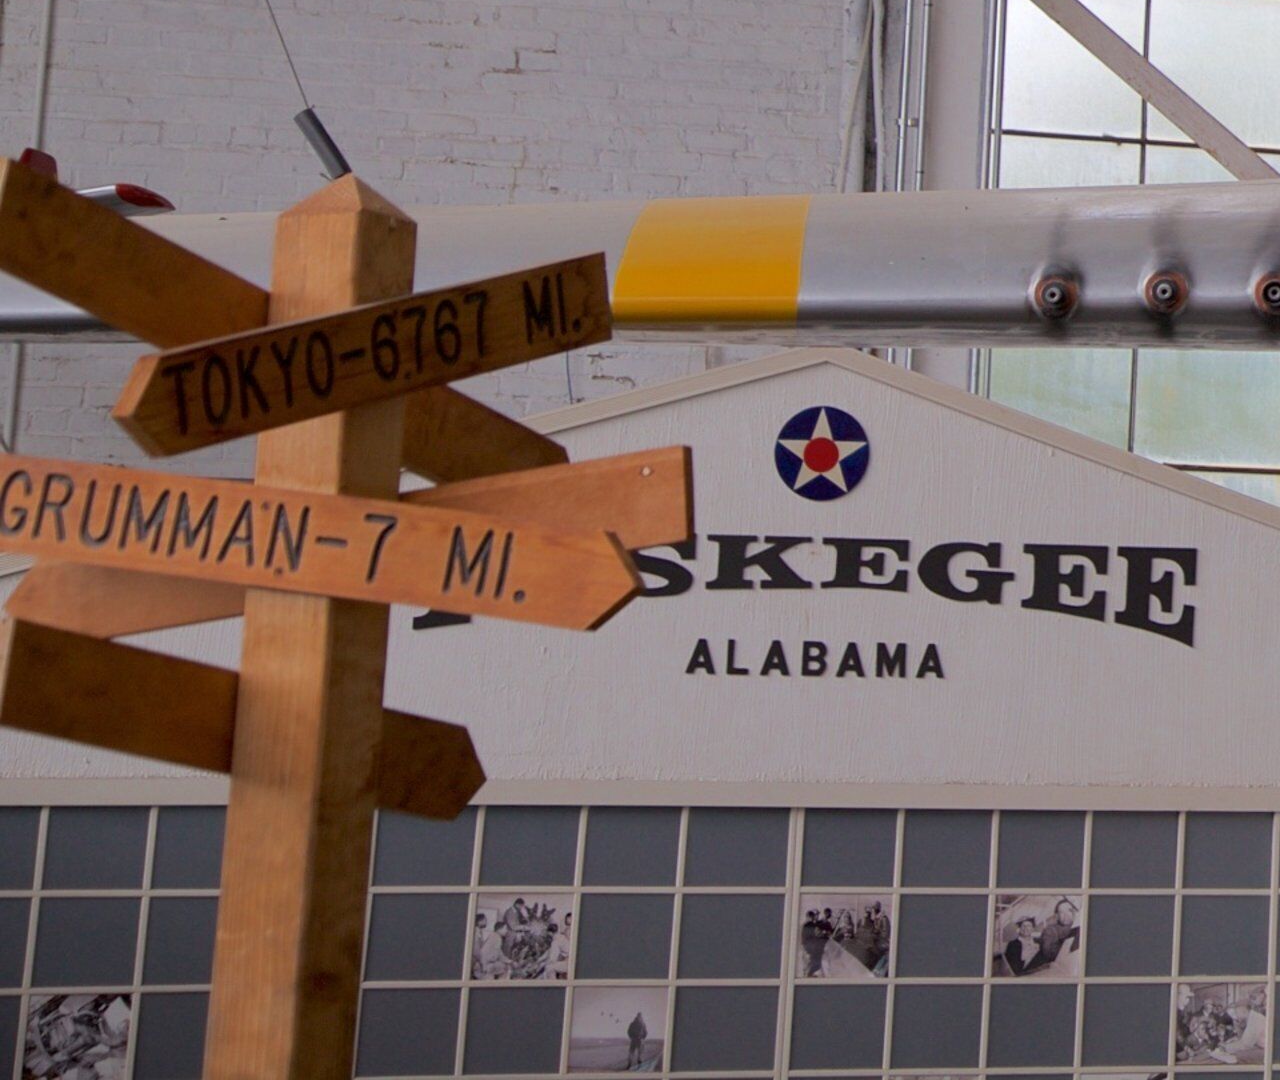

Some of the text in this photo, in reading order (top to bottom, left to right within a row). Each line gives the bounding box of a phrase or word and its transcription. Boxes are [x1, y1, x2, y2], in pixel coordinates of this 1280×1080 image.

[163, 272, 583, 435] TOKYO-6767 MI.
[0, 470, 526, 604] GRUMMAN-7 MI.
[413, 532, 1199, 648] SKEGEE
[685, 638, 946, 680] ALABAMA
